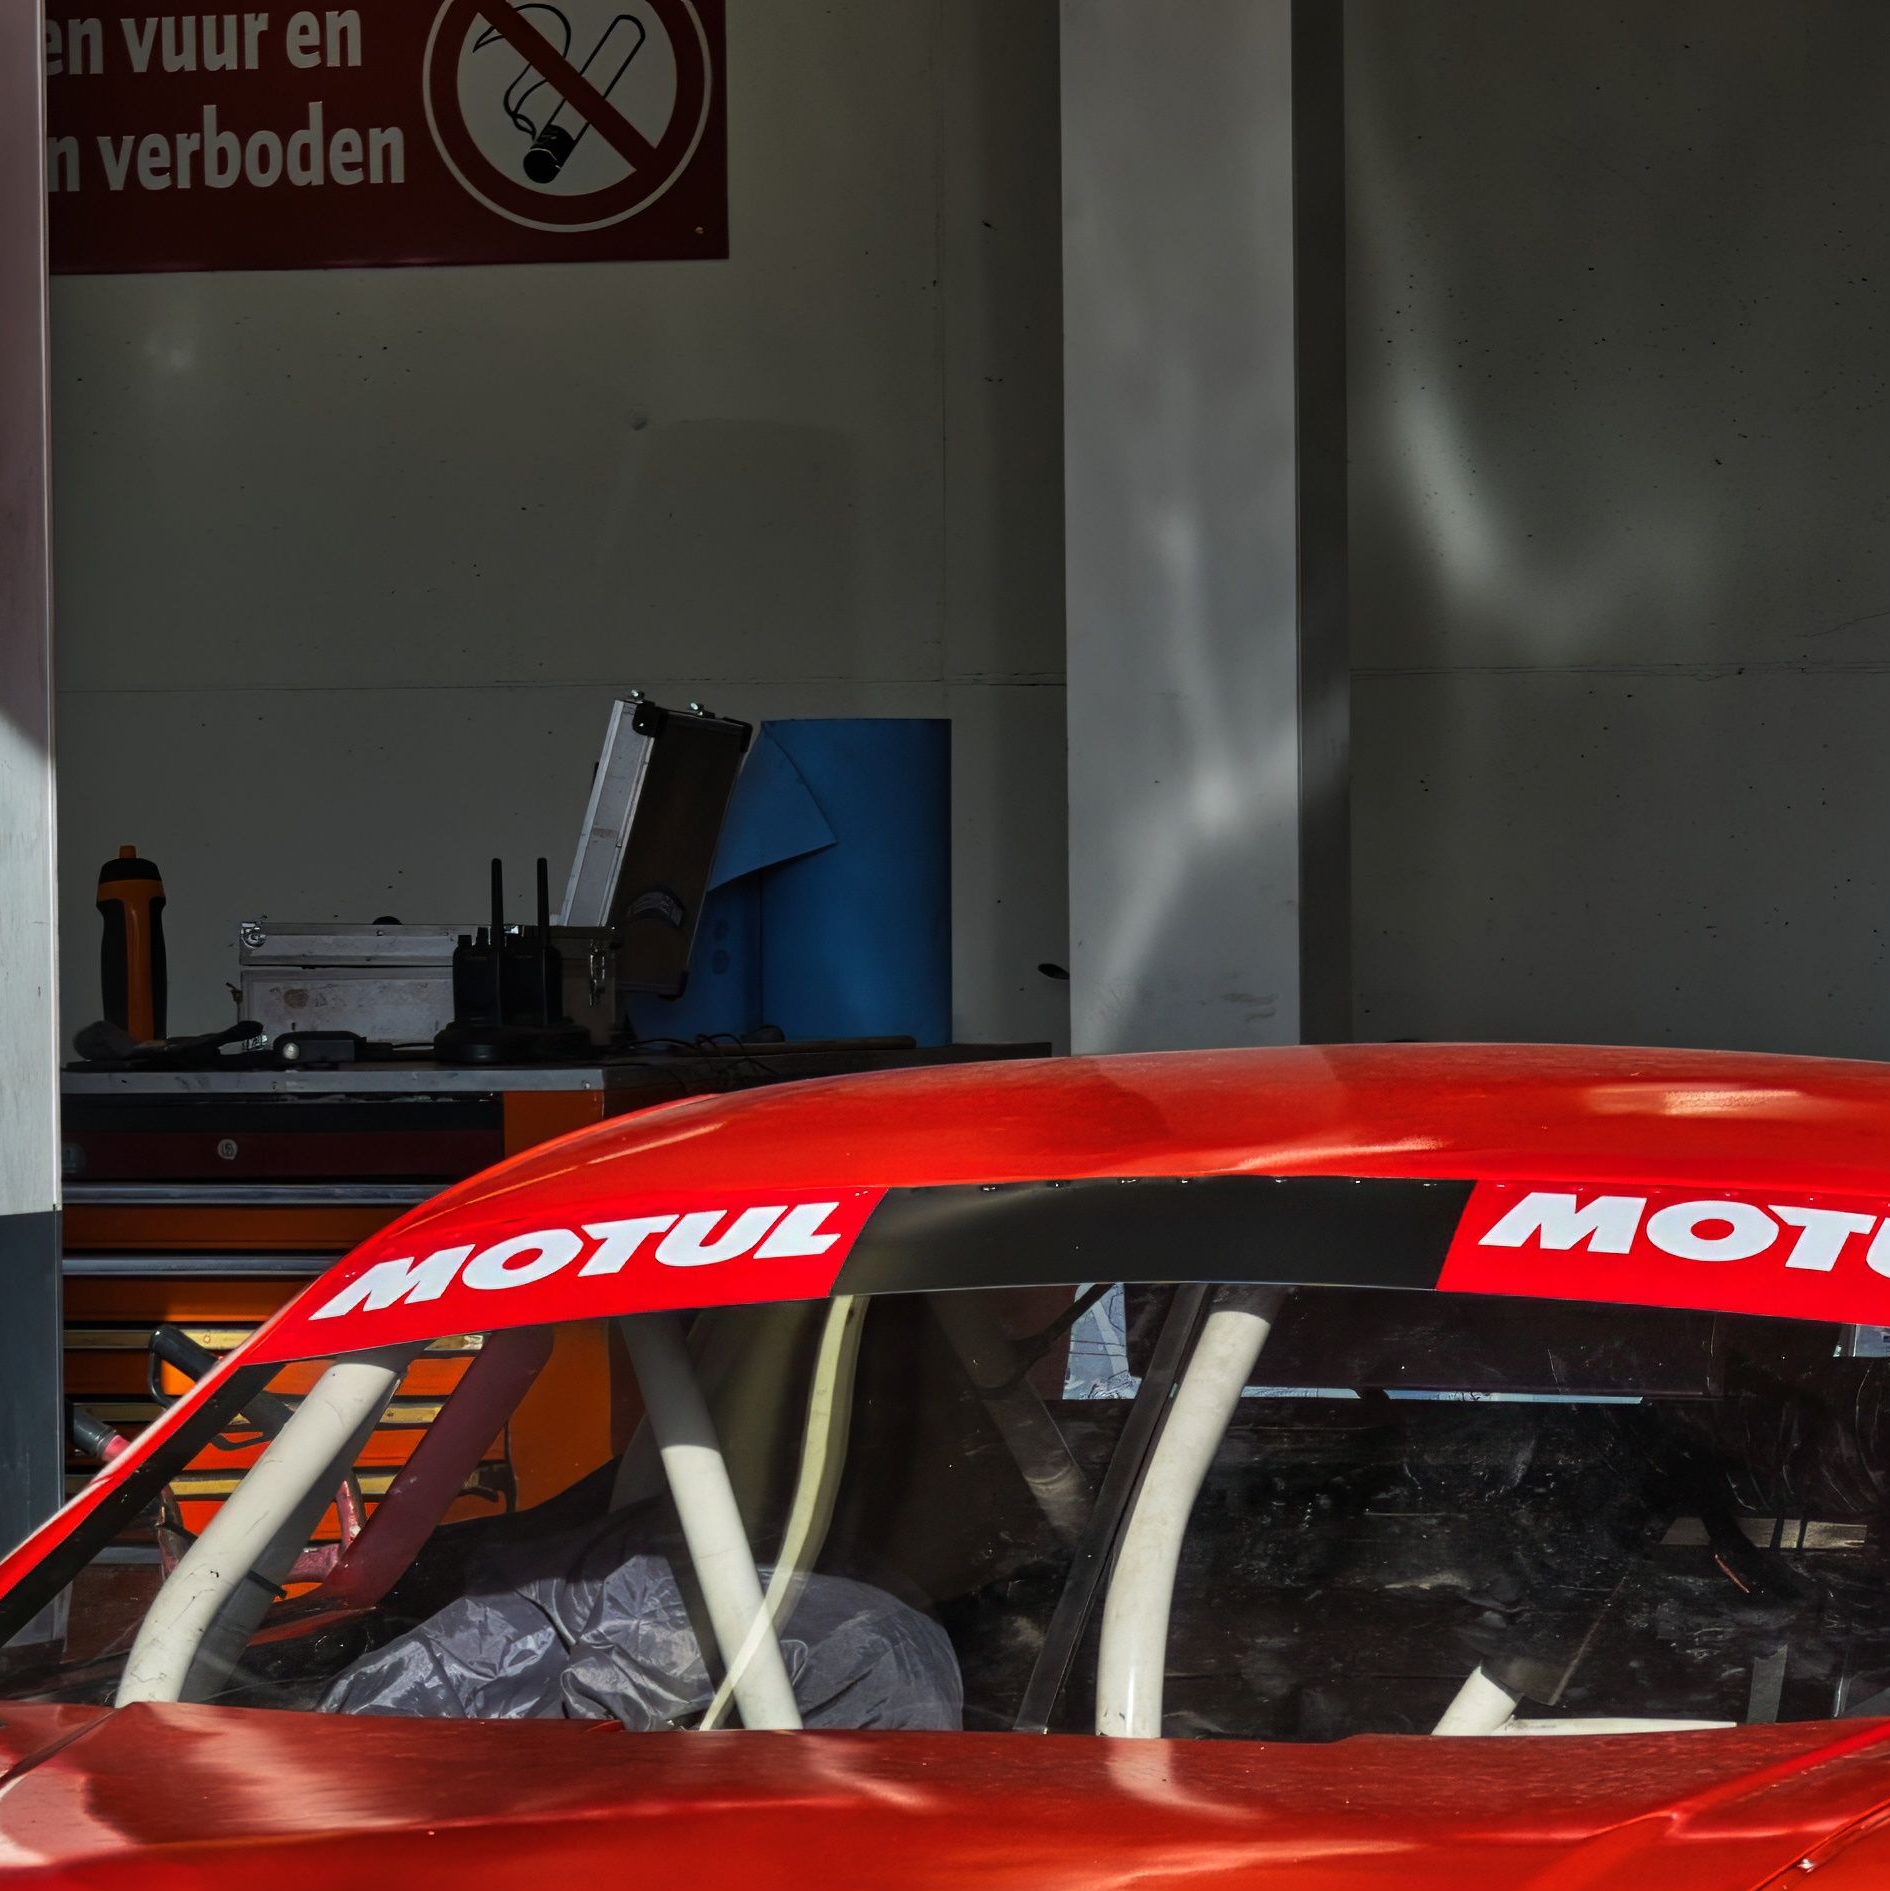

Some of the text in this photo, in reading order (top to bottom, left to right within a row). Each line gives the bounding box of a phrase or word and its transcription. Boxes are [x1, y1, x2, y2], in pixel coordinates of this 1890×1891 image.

[120, 11, 270, 74] vuur
[285, 8, 363, 70] en
[96, 100, 407, 193] verboden
[309, 1202, 841, 1320] MOTUL
